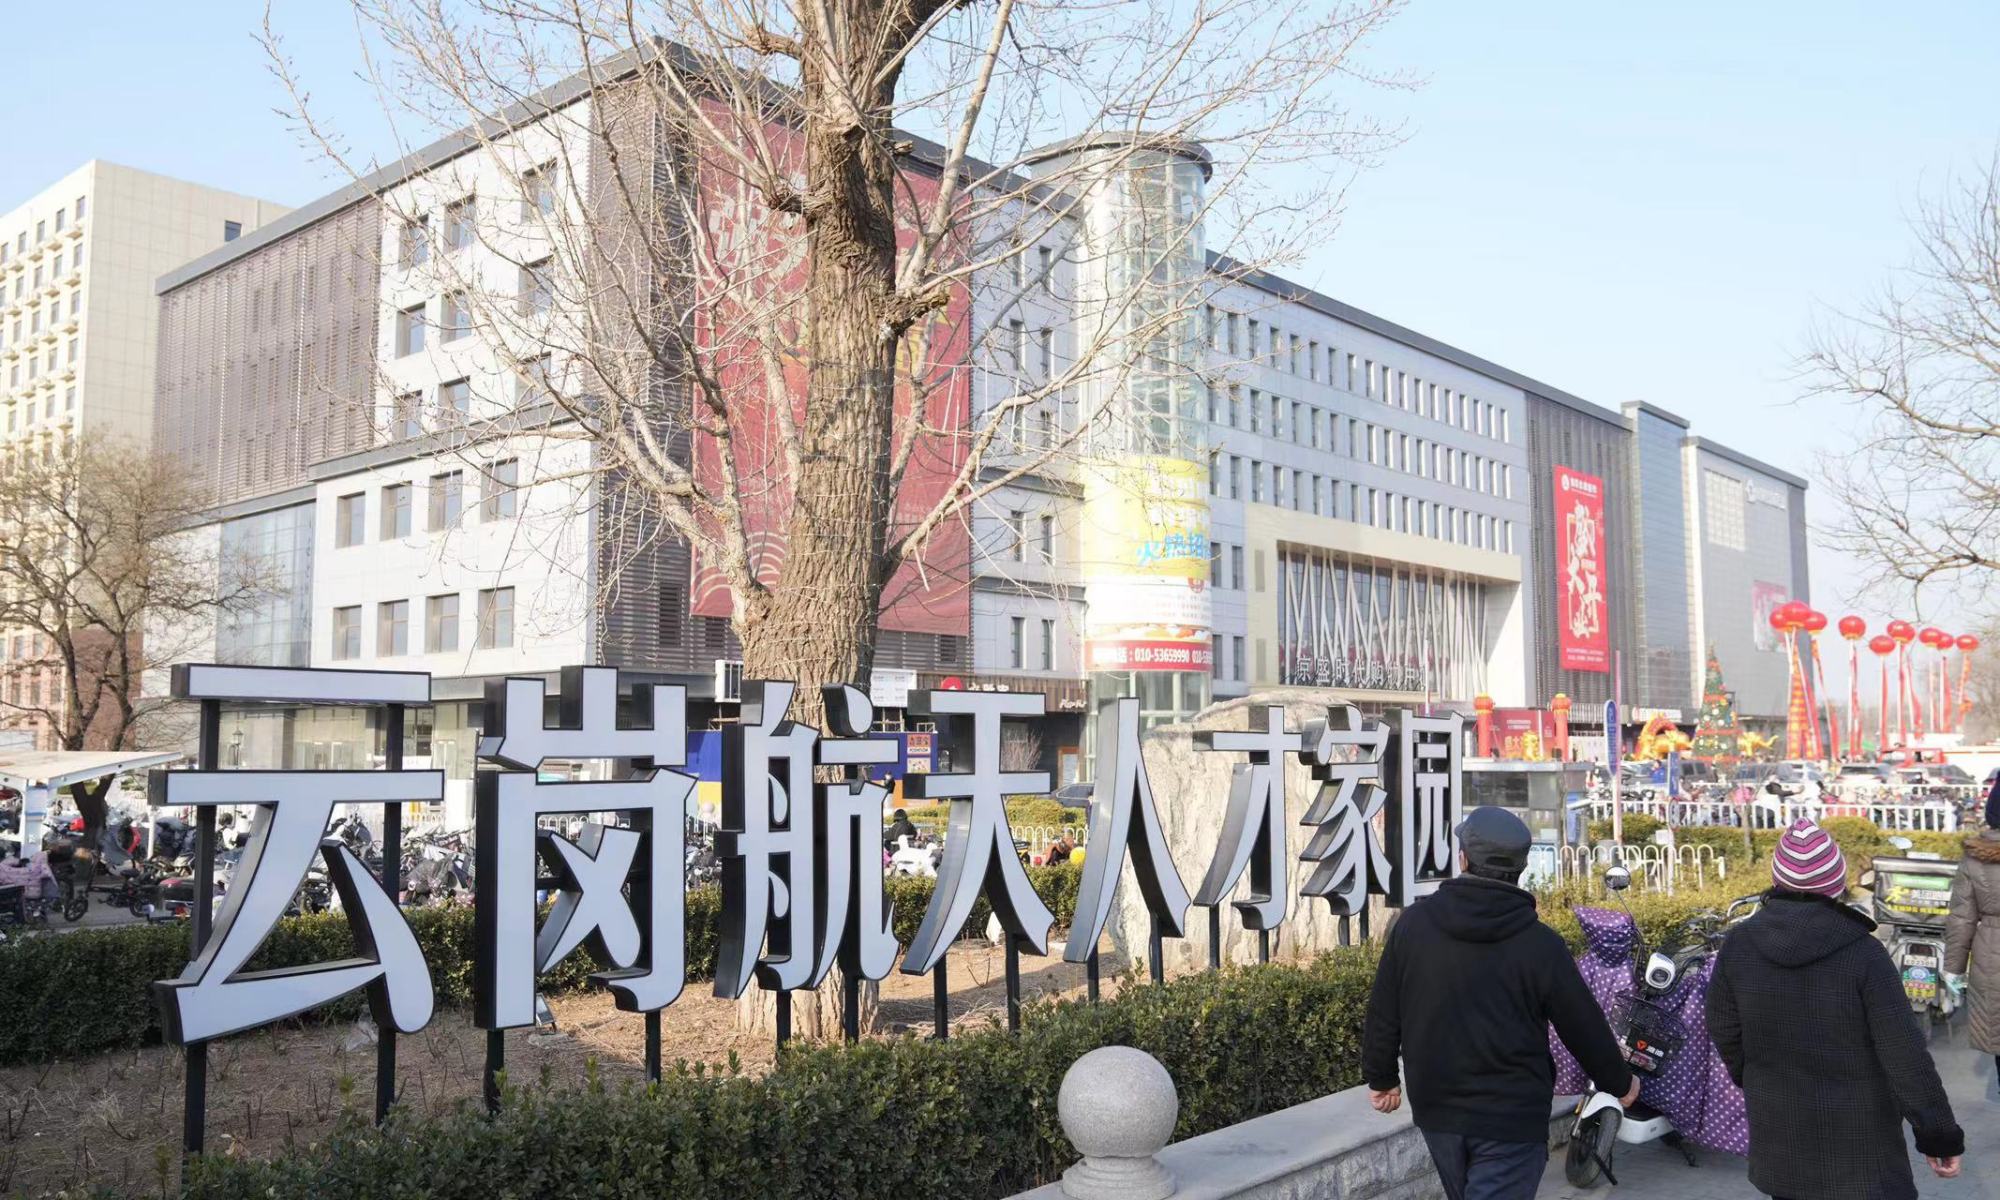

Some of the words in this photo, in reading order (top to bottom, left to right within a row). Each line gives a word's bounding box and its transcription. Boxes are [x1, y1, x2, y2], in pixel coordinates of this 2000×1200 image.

[150, 663, 1466, 1043] 云岗航天人才家园
